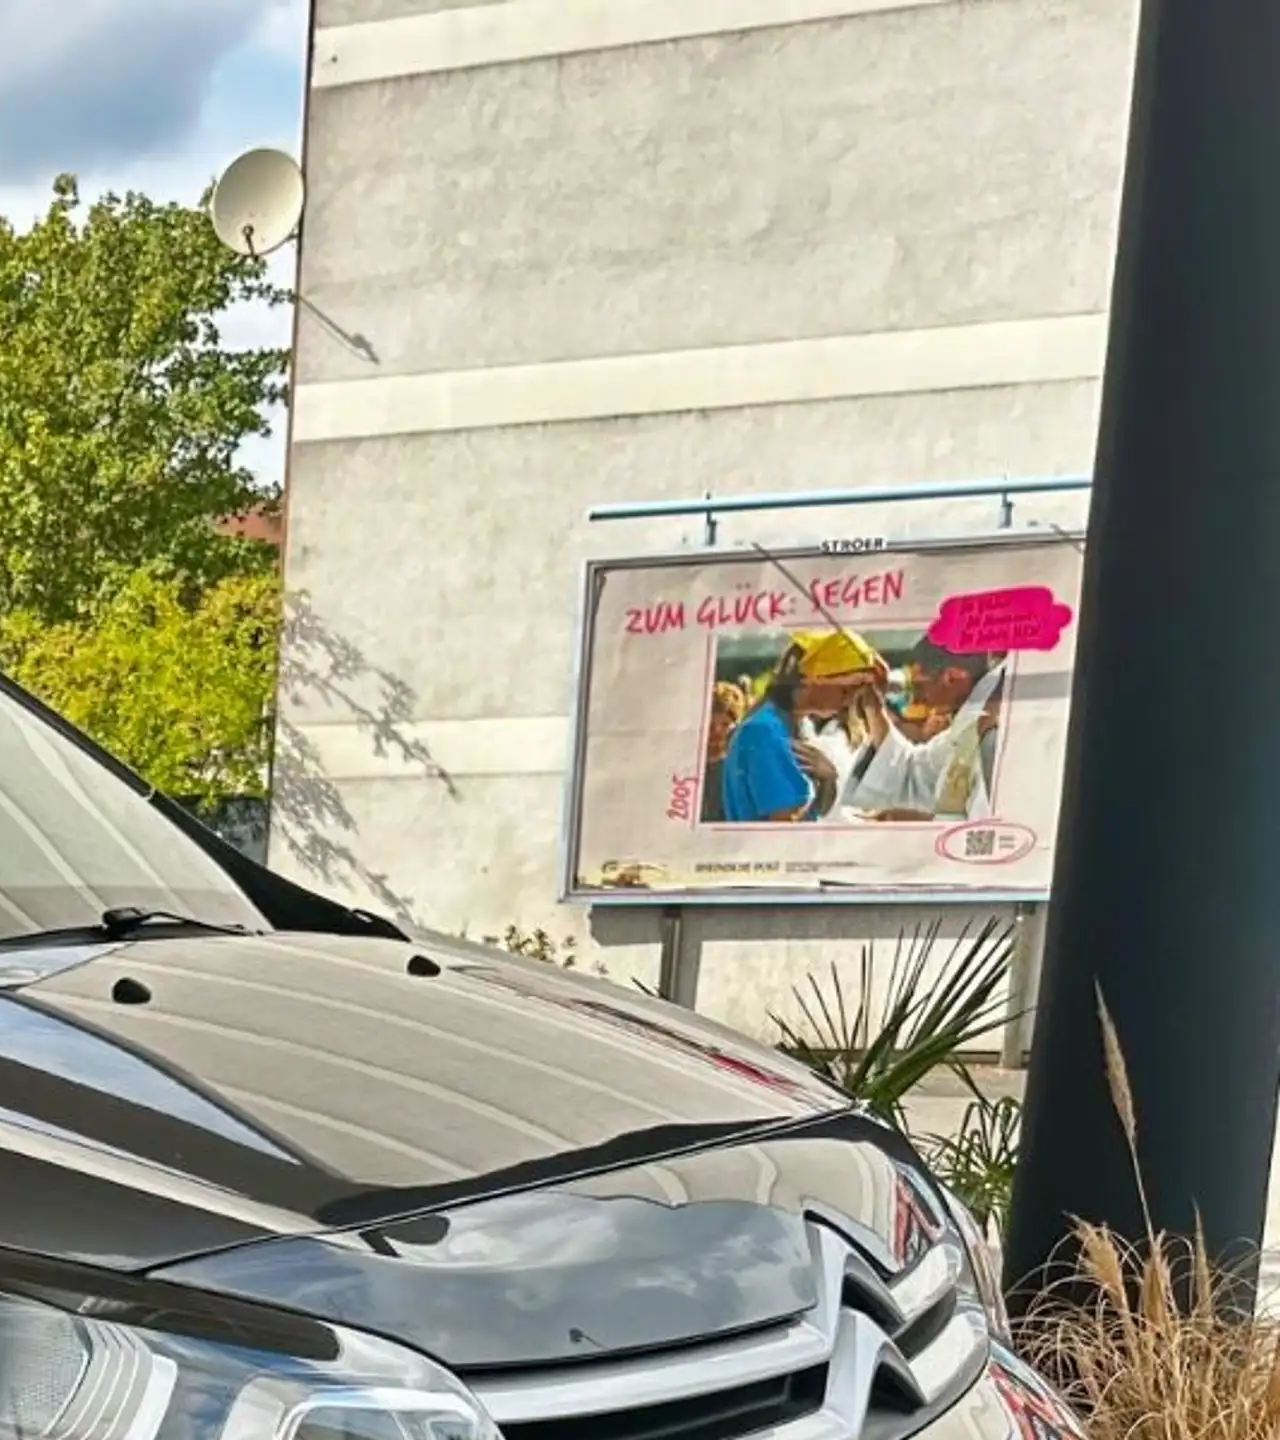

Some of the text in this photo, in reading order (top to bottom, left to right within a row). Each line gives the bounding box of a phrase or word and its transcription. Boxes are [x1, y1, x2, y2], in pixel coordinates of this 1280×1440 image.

[625, 601, 684, 634] ZUM
[809, 569, 904, 613] SEGEN
[666, 773, 691, 821] 2005
